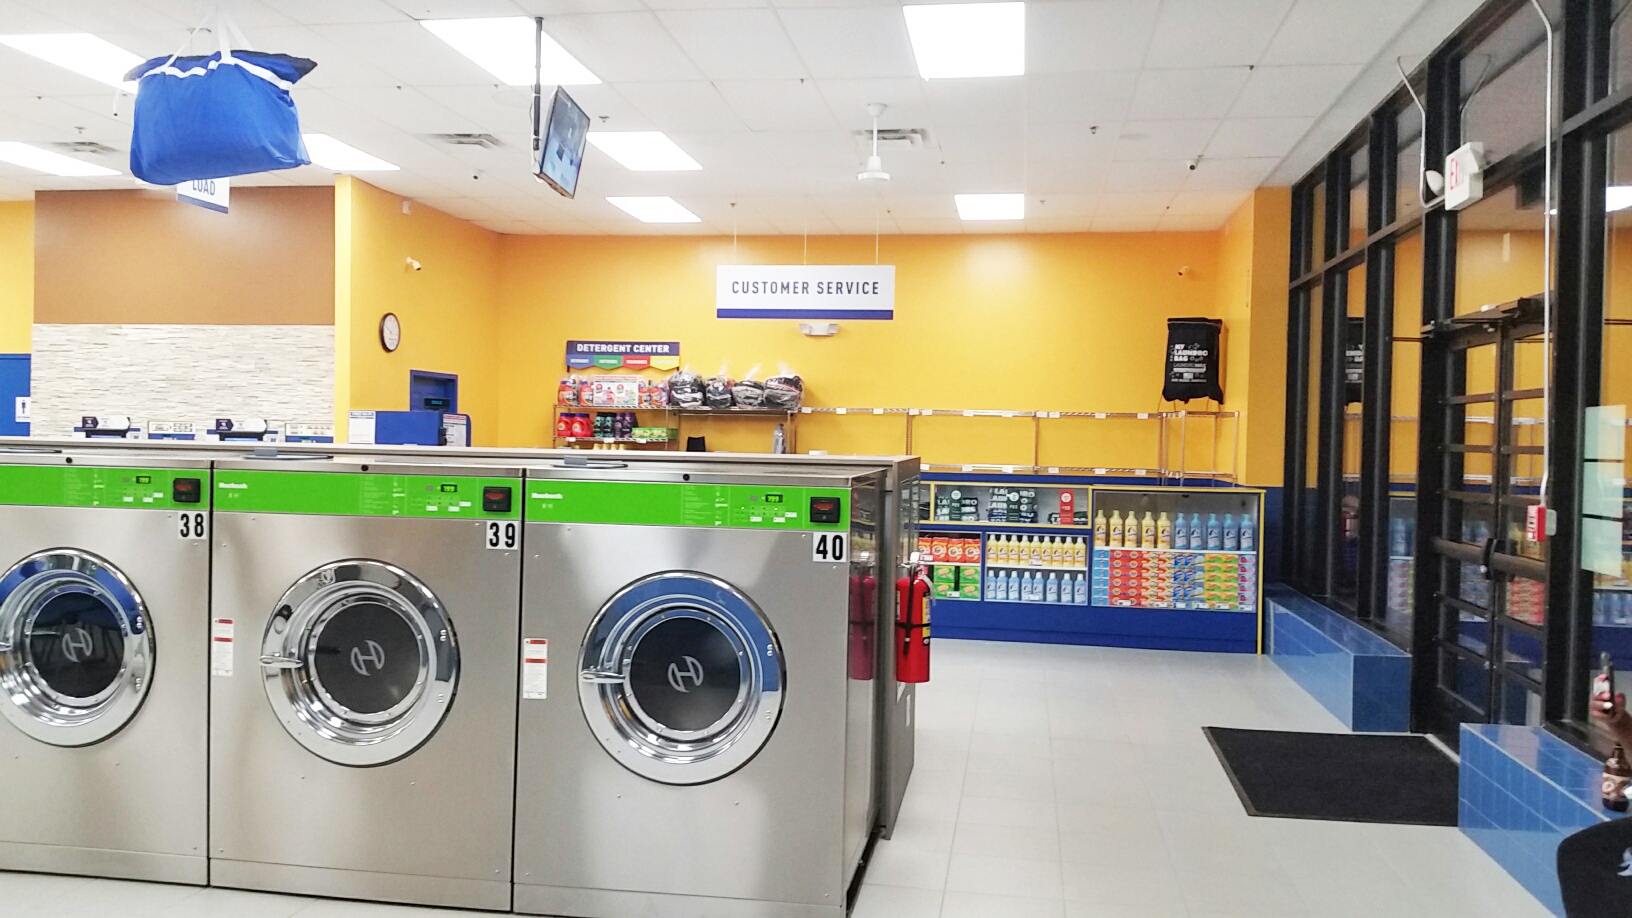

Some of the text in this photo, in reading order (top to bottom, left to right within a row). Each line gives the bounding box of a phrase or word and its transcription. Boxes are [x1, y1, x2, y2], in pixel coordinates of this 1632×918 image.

[731, 280, 880, 296] CUSTOMER SERVICE
[576, 343, 670, 353] DETERGENT CENTER
[180, 513, 204, 538] 38
[489, 522, 516, 548] 39
[815, 534, 844, 561] 40
